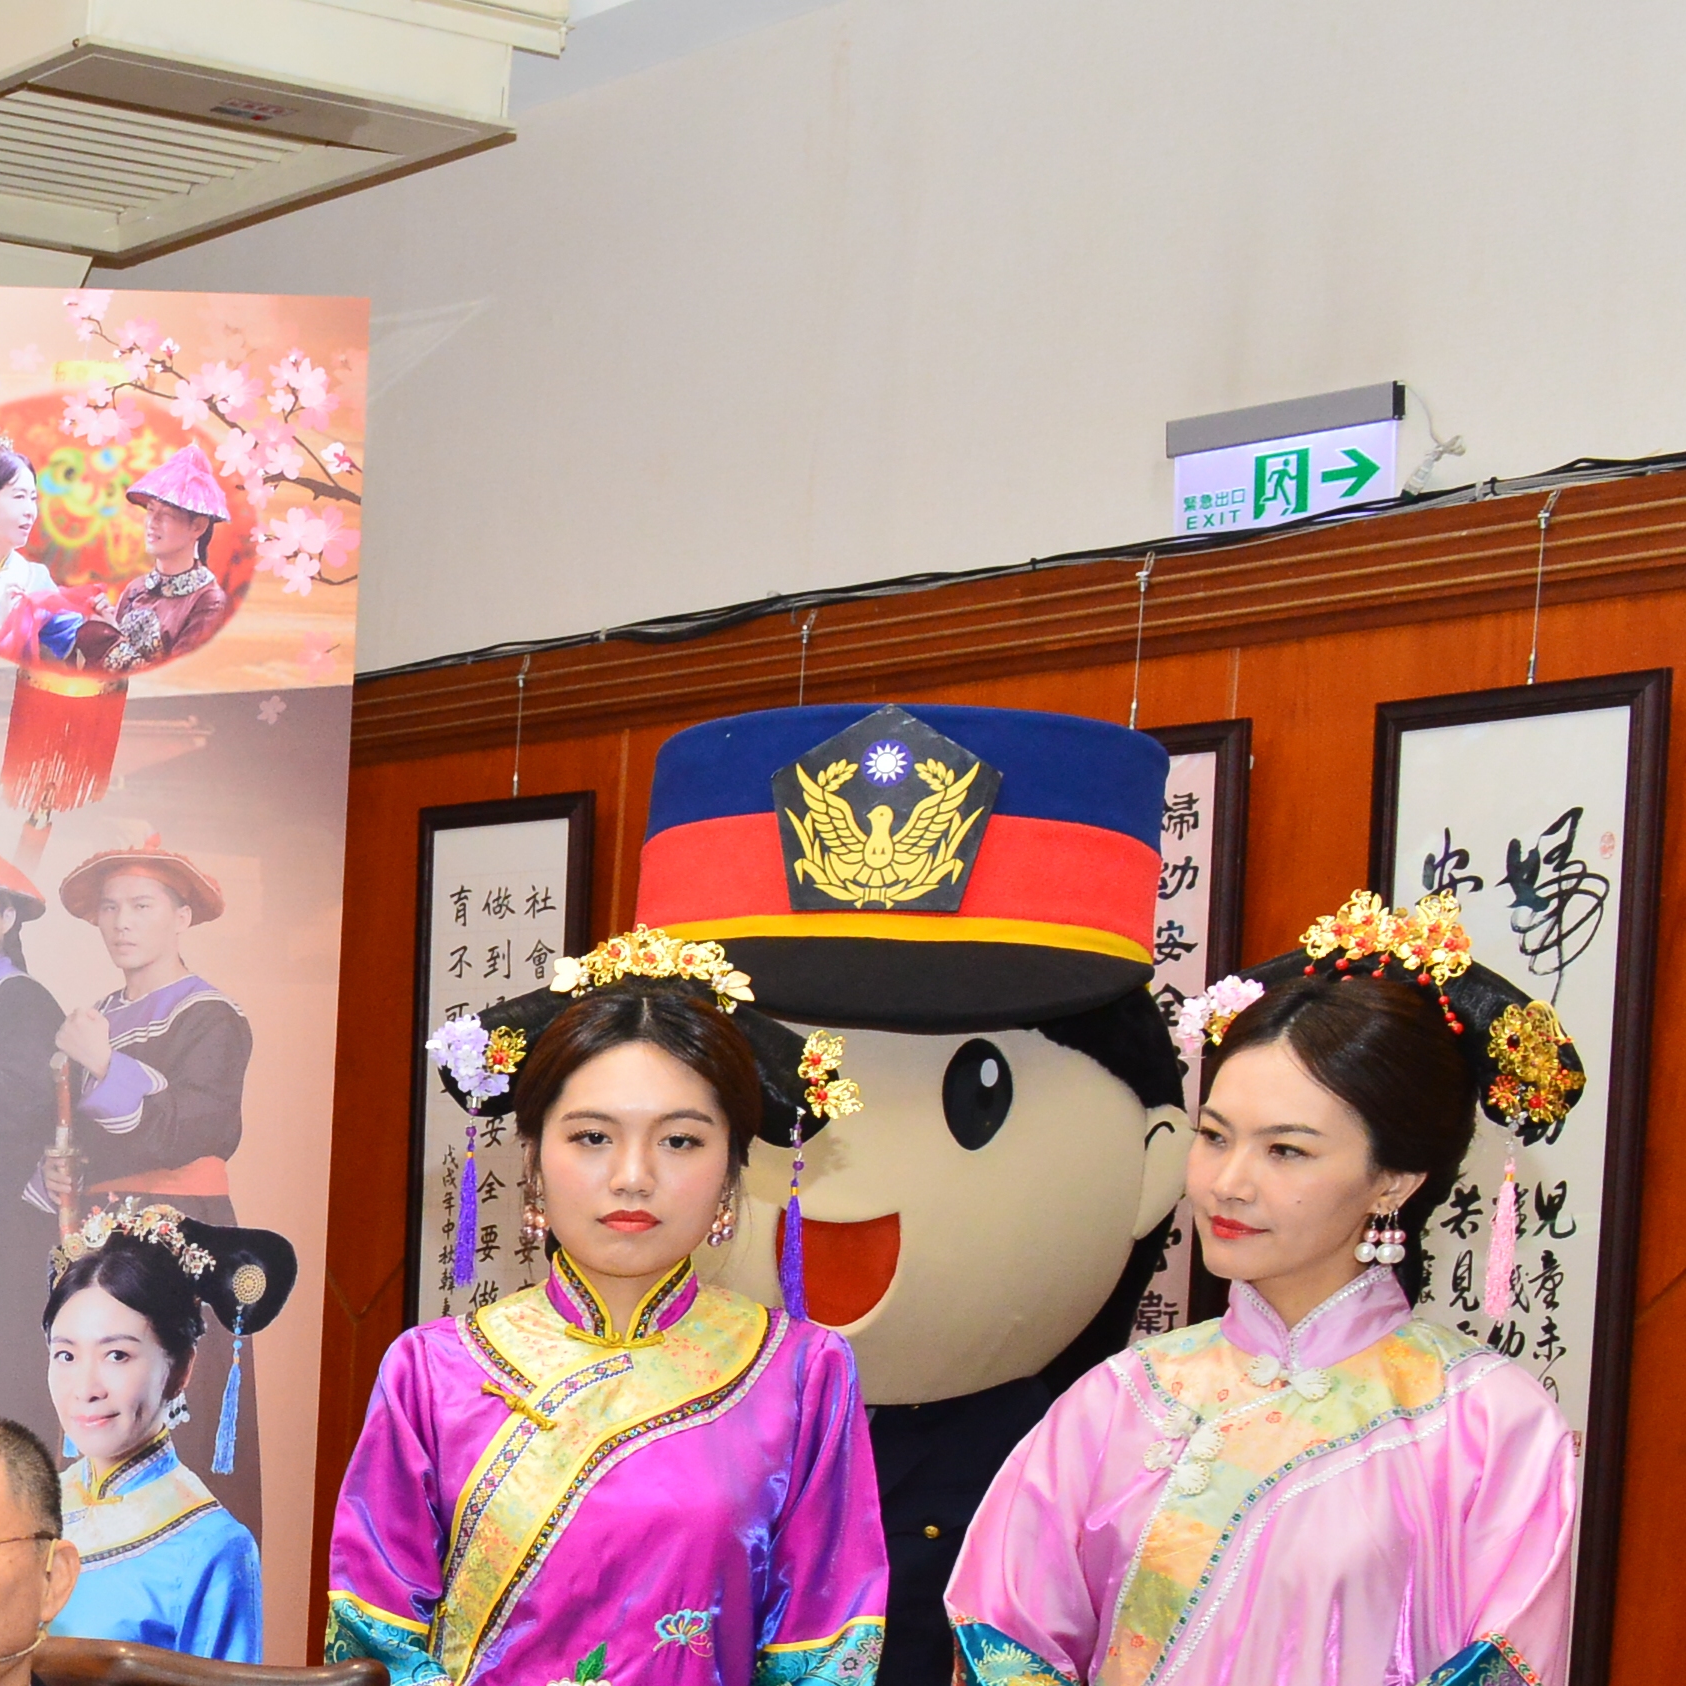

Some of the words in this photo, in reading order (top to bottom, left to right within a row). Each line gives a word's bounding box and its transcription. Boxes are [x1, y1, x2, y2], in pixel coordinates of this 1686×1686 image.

[1184, 490, 1245, 512] 緊急出口
[1186, 510, 1241, 531] EXIT
